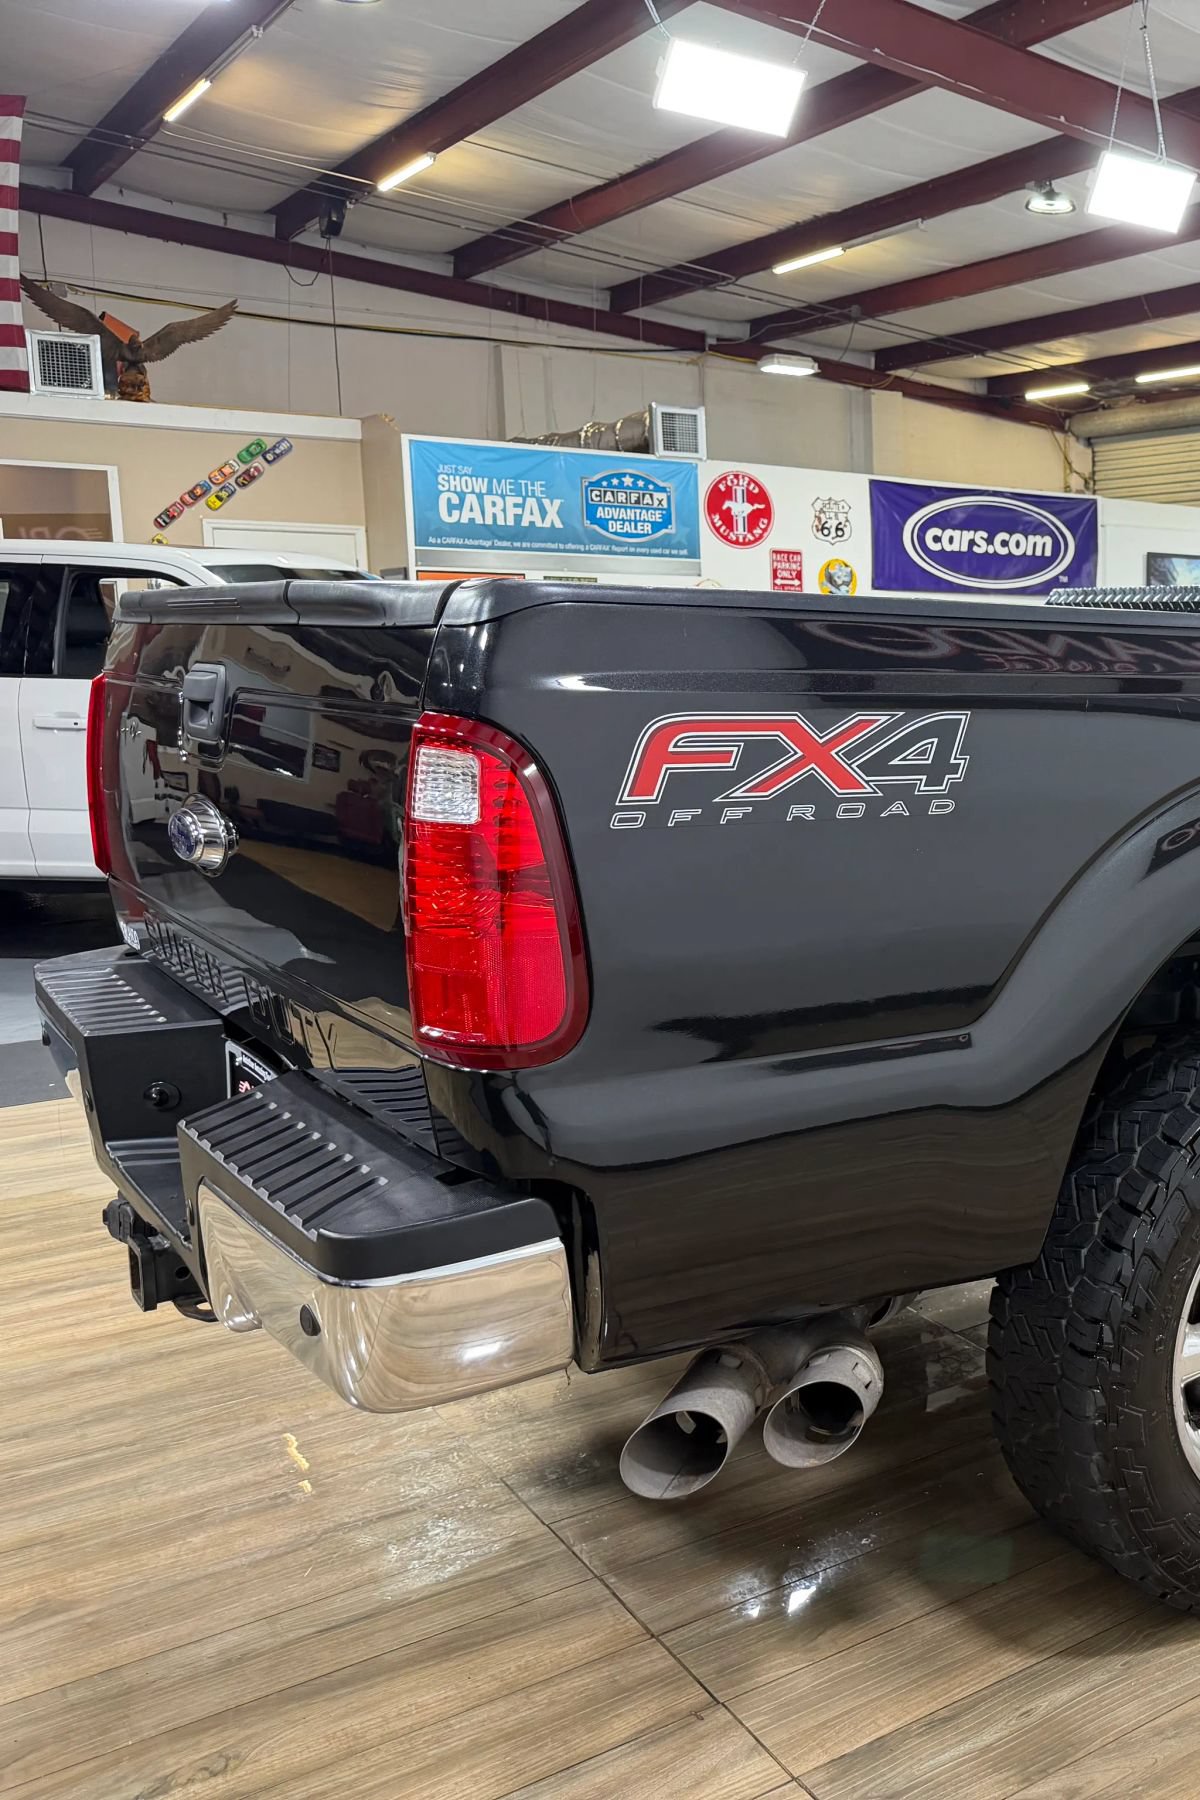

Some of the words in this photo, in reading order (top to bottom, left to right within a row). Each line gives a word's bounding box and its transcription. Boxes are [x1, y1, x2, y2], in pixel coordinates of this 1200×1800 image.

[437, 463, 456, 473] JUST
[458, 465, 473, 475] SAY
[437, 474, 488, 494] SHOW
[492, 478, 516, 496] ME
[518, 480, 546, 498] THE
[718, 474, 760, 494] FORD
[590, 489, 667, 508] CARFAX
[438, 491, 564, 529] CARFAX
[597, 507, 664, 523] ADVANTAGE
[608, 521, 652, 534] DEALER
[711, 513, 768, 543] MUSTANG
[821, 520, 845, 540] 66
[925, 527, 1053, 557] cars.com
[772, 552, 788, 561] RACE
[788, 553, 801, 562] CAR
[773, 561, 801, 571] PARKING
[776, 570, 797, 579] ONLY
[615, 711, 971, 806] FX4
[609, 806, 753, 829] OFF
[786, 799, 957, 822] ROAD
